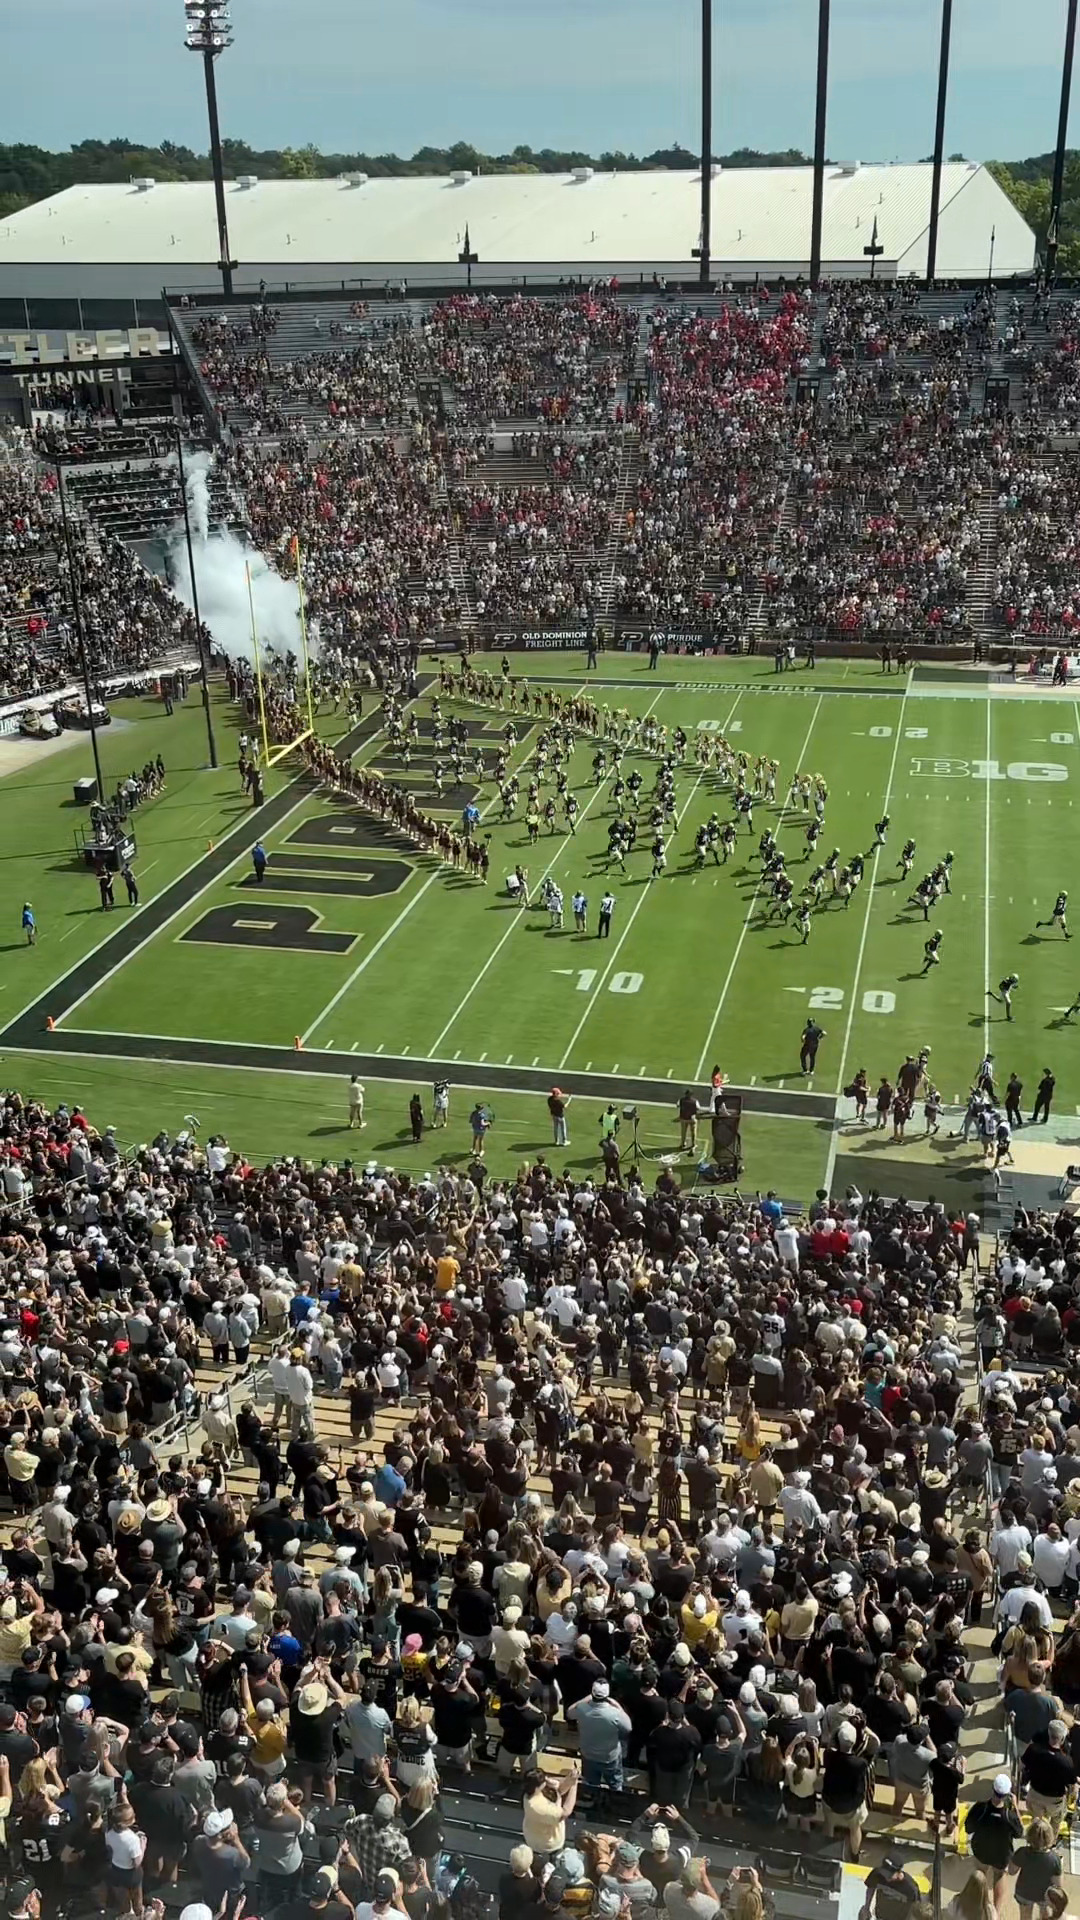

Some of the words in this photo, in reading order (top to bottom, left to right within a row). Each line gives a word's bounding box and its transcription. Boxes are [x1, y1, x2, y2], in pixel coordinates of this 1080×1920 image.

[13, 368, 132, 388] TUNNEL
[522, 632, 541, 640] OLD
[542, 631, 587, 639] DOMINION
[667, 634, 703, 642] PURDUE
[525, 640, 563, 648] FREIGHT
[565, 639, 586, 647] LINE
[869, 726, 929, 739] 20
[575, 968, 645, 994] 10
[808, 986, 897, 1014] 20
[763, 1321, 779, 1333] 25
[999, 1438, 1017, 1454] 15
[22, 1838, 52, 1862] 21
